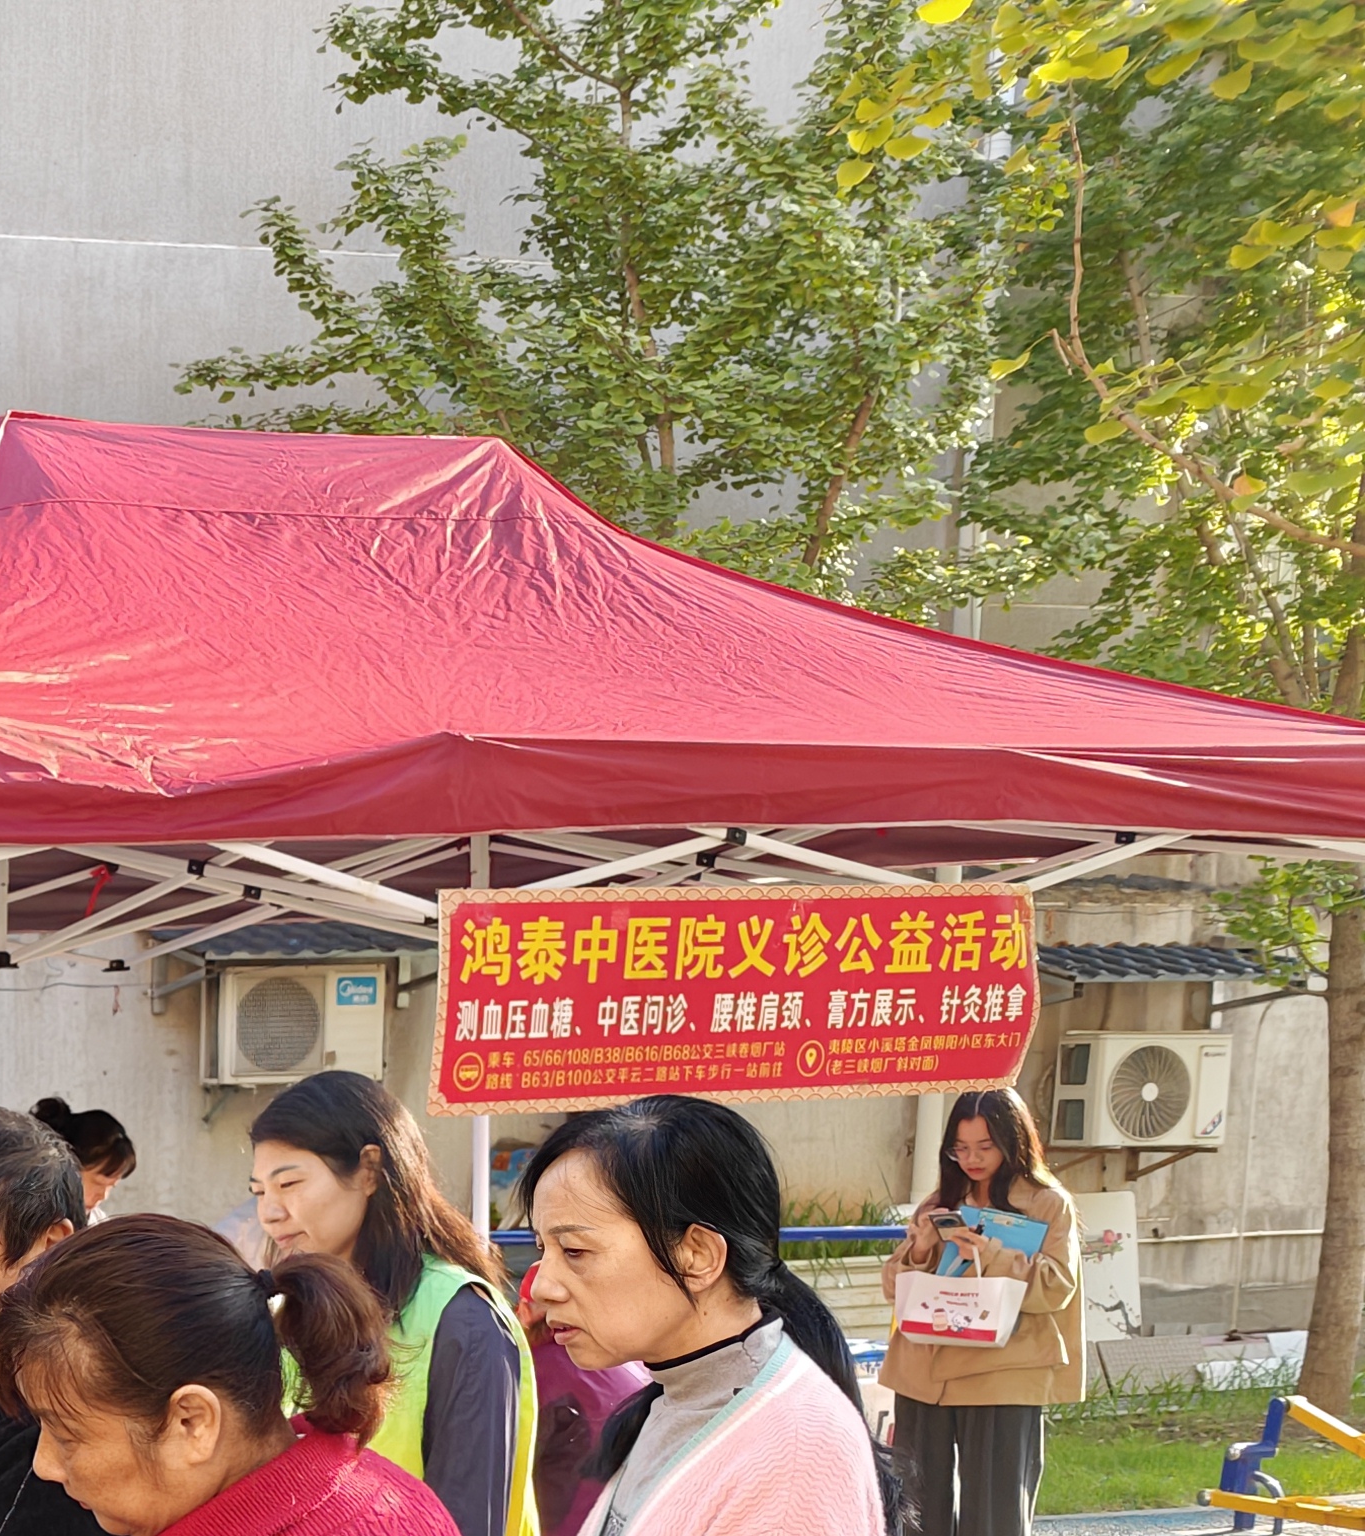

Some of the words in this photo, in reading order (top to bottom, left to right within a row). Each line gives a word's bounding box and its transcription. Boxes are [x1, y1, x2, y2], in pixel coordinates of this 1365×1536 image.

[459, 909, 1028, 986] 鸿泰中医院义诊公益活动
